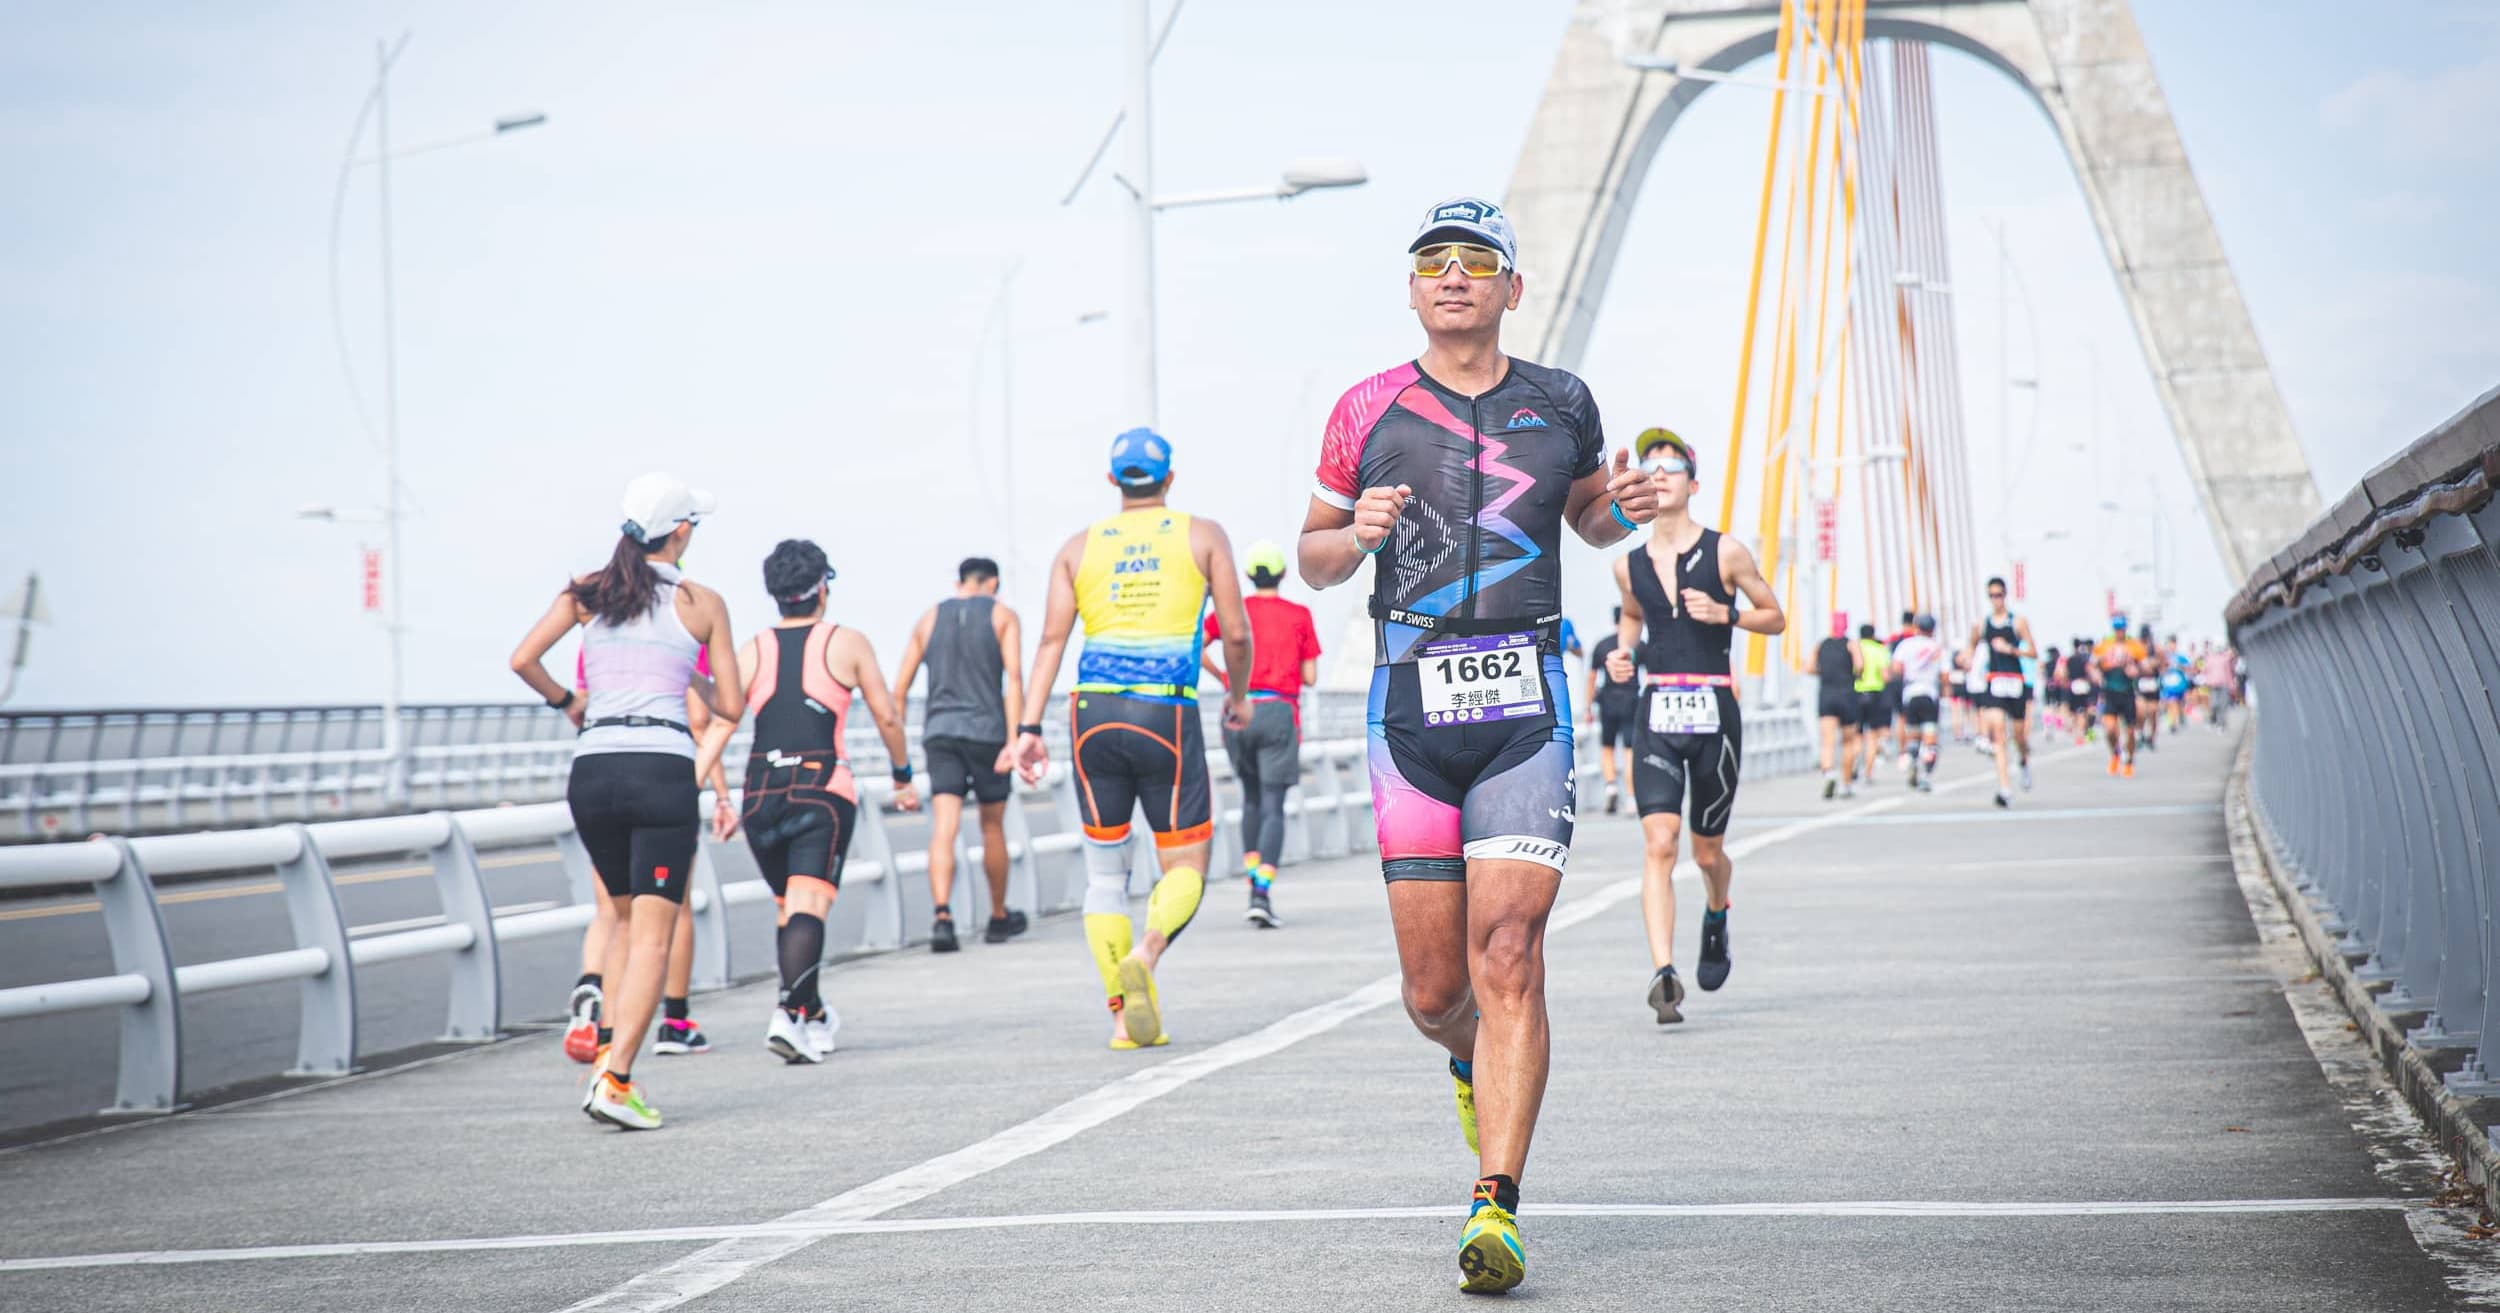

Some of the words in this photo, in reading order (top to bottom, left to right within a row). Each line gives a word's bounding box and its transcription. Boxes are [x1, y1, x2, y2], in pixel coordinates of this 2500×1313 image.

[1506, 415, 1549, 429] LAVA
[1390, 609, 1405, 622] DT
[1406, 613, 1435, 628] SWISS
[1436, 651, 1522, 685] 1662
[1451, 688, 1501, 708] 李經傑
[1662, 695, 1706, 710] 1141
